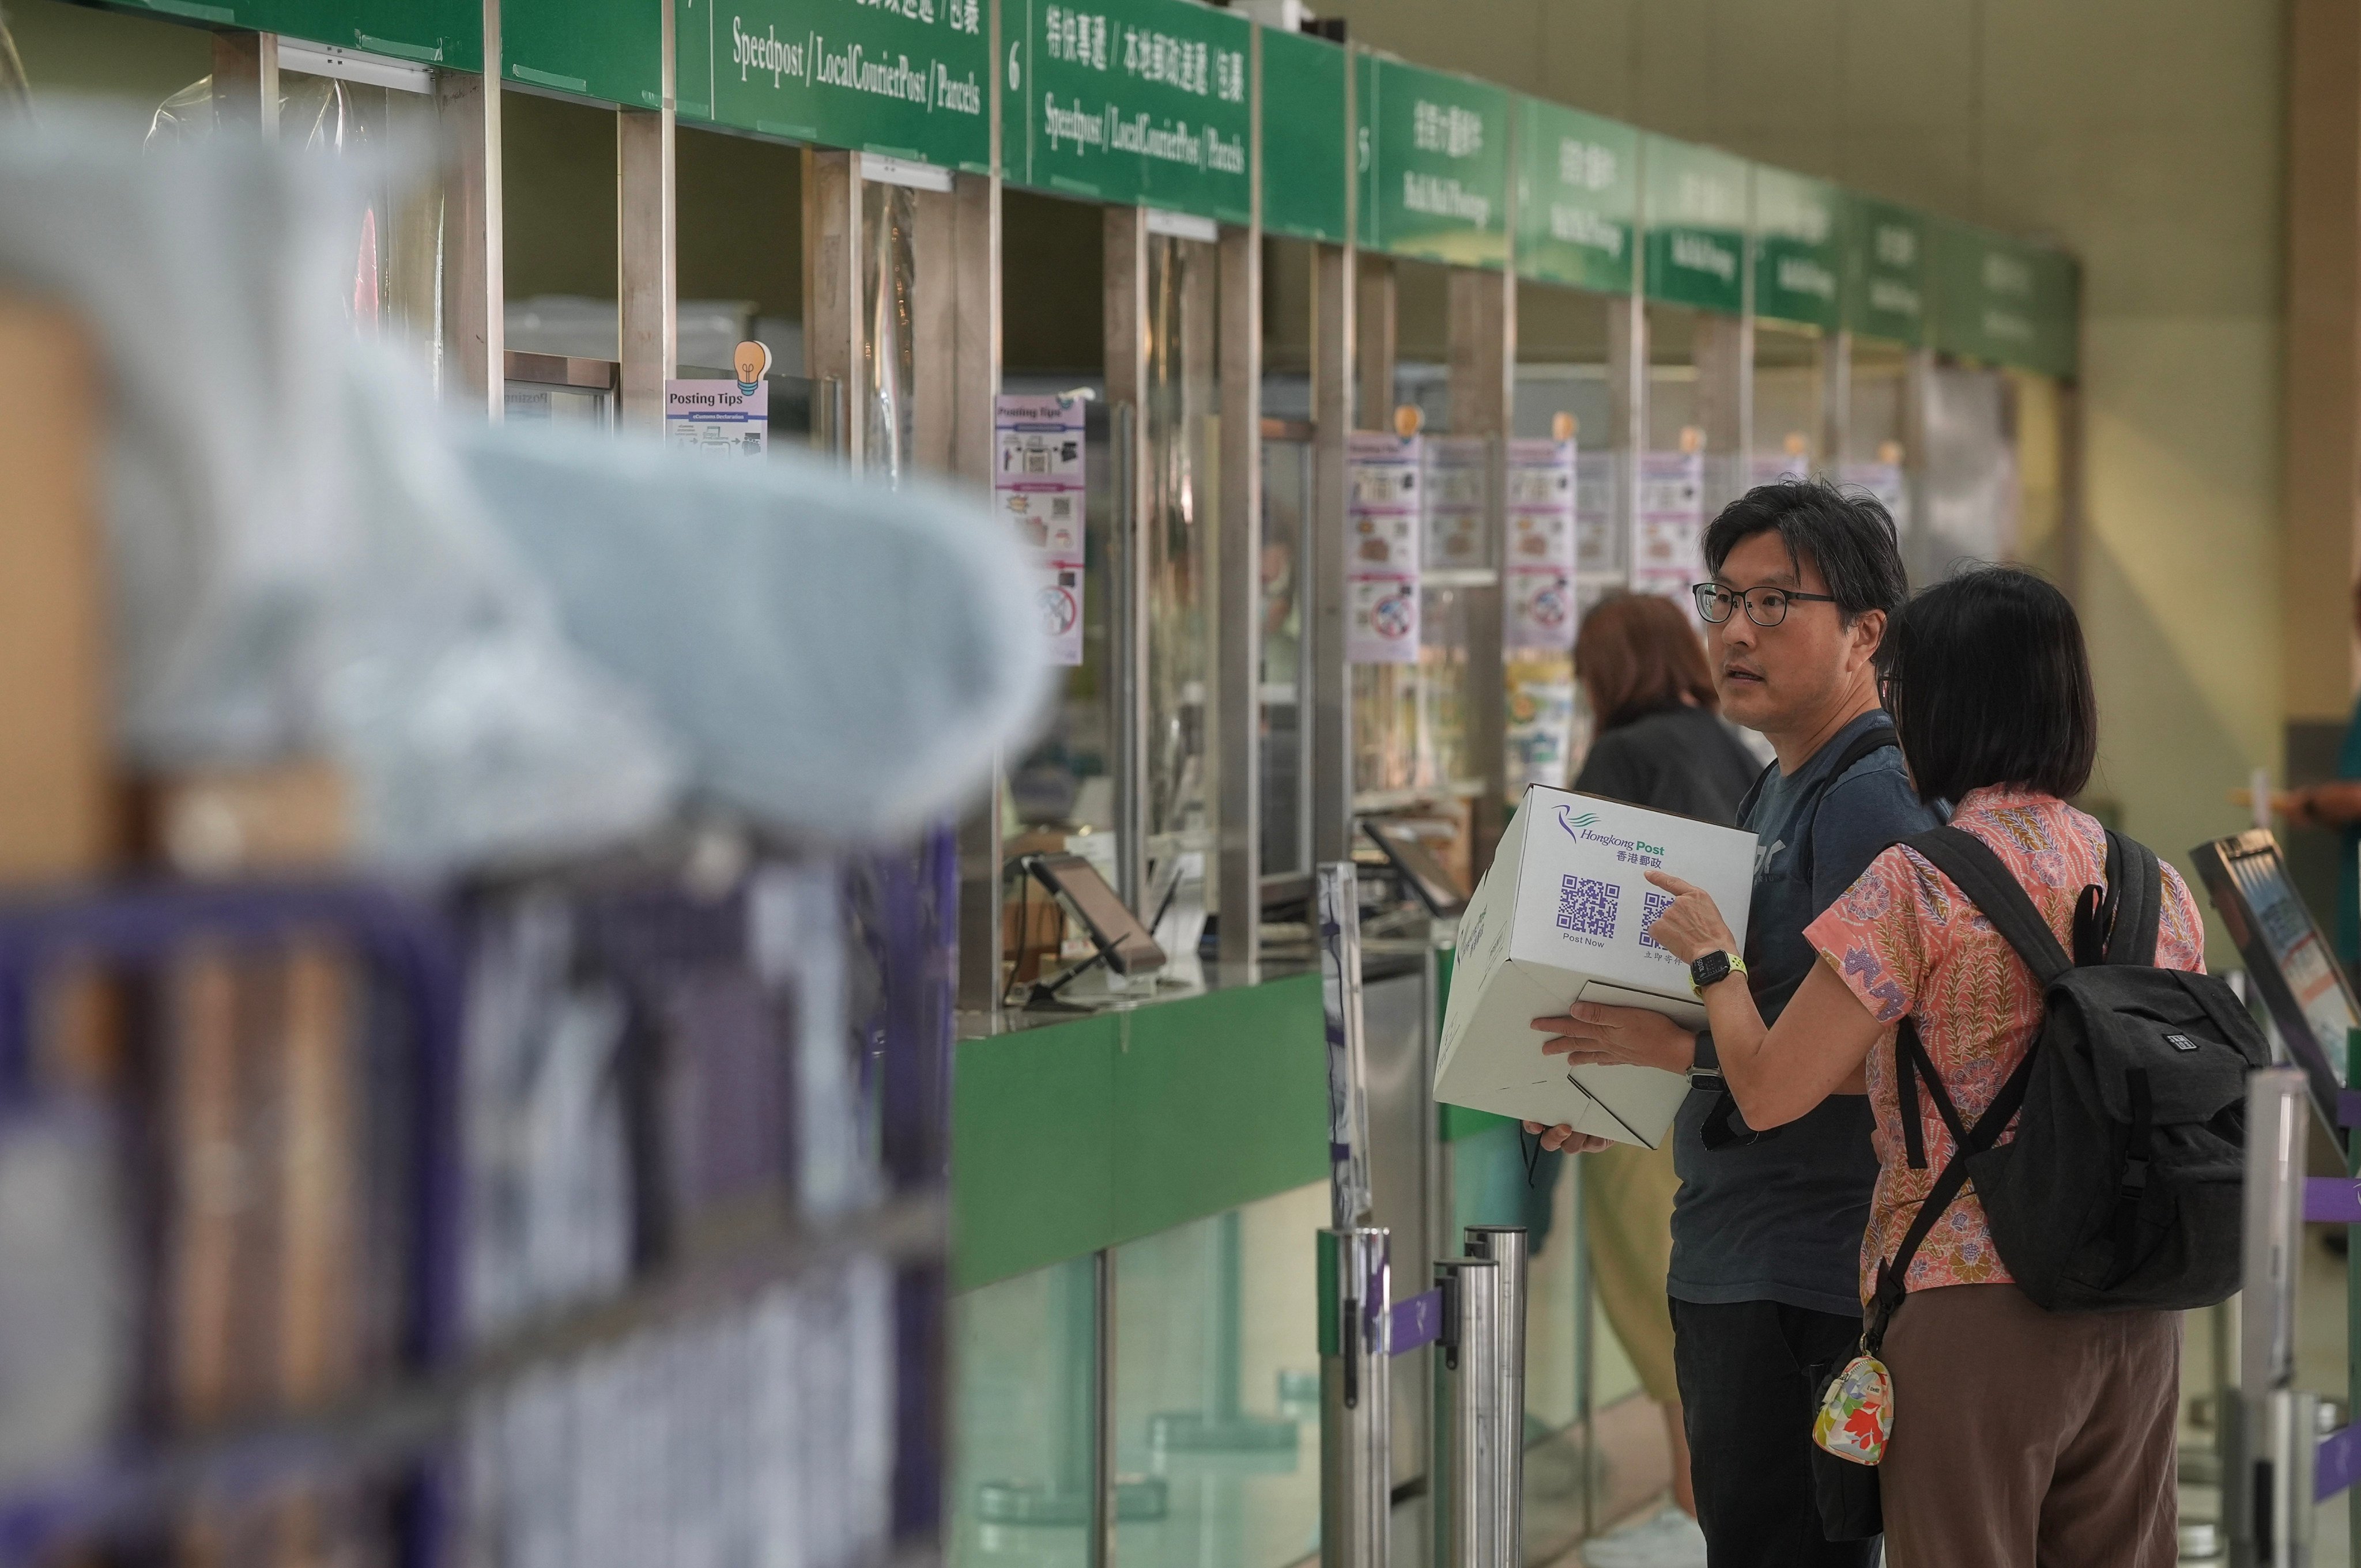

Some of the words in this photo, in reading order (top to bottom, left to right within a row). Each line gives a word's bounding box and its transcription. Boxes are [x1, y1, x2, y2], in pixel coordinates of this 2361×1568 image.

[733, 16, 804, 89] Speedpost
[816, 36, 927, 103] LocalCourierPost
[937, 63, 981, 115] Parcels
[1008, 41, 1020, 91] 6
[1044, 92, 1102, 156] Speedpost
[670, 392, 715, 406] Posting
[718, 392, 743, 406] Tips
[1580, 829, 1635, 851] Hongkong
[1636, 841, 1665, 856] Post
[1616, 851, 1662, 869] 香港郵政
[1563, 932, 1583, 944] Post
[1585, 938, 1605, 948] Now
[1643, 951, 1683, 966] 立即寄件
